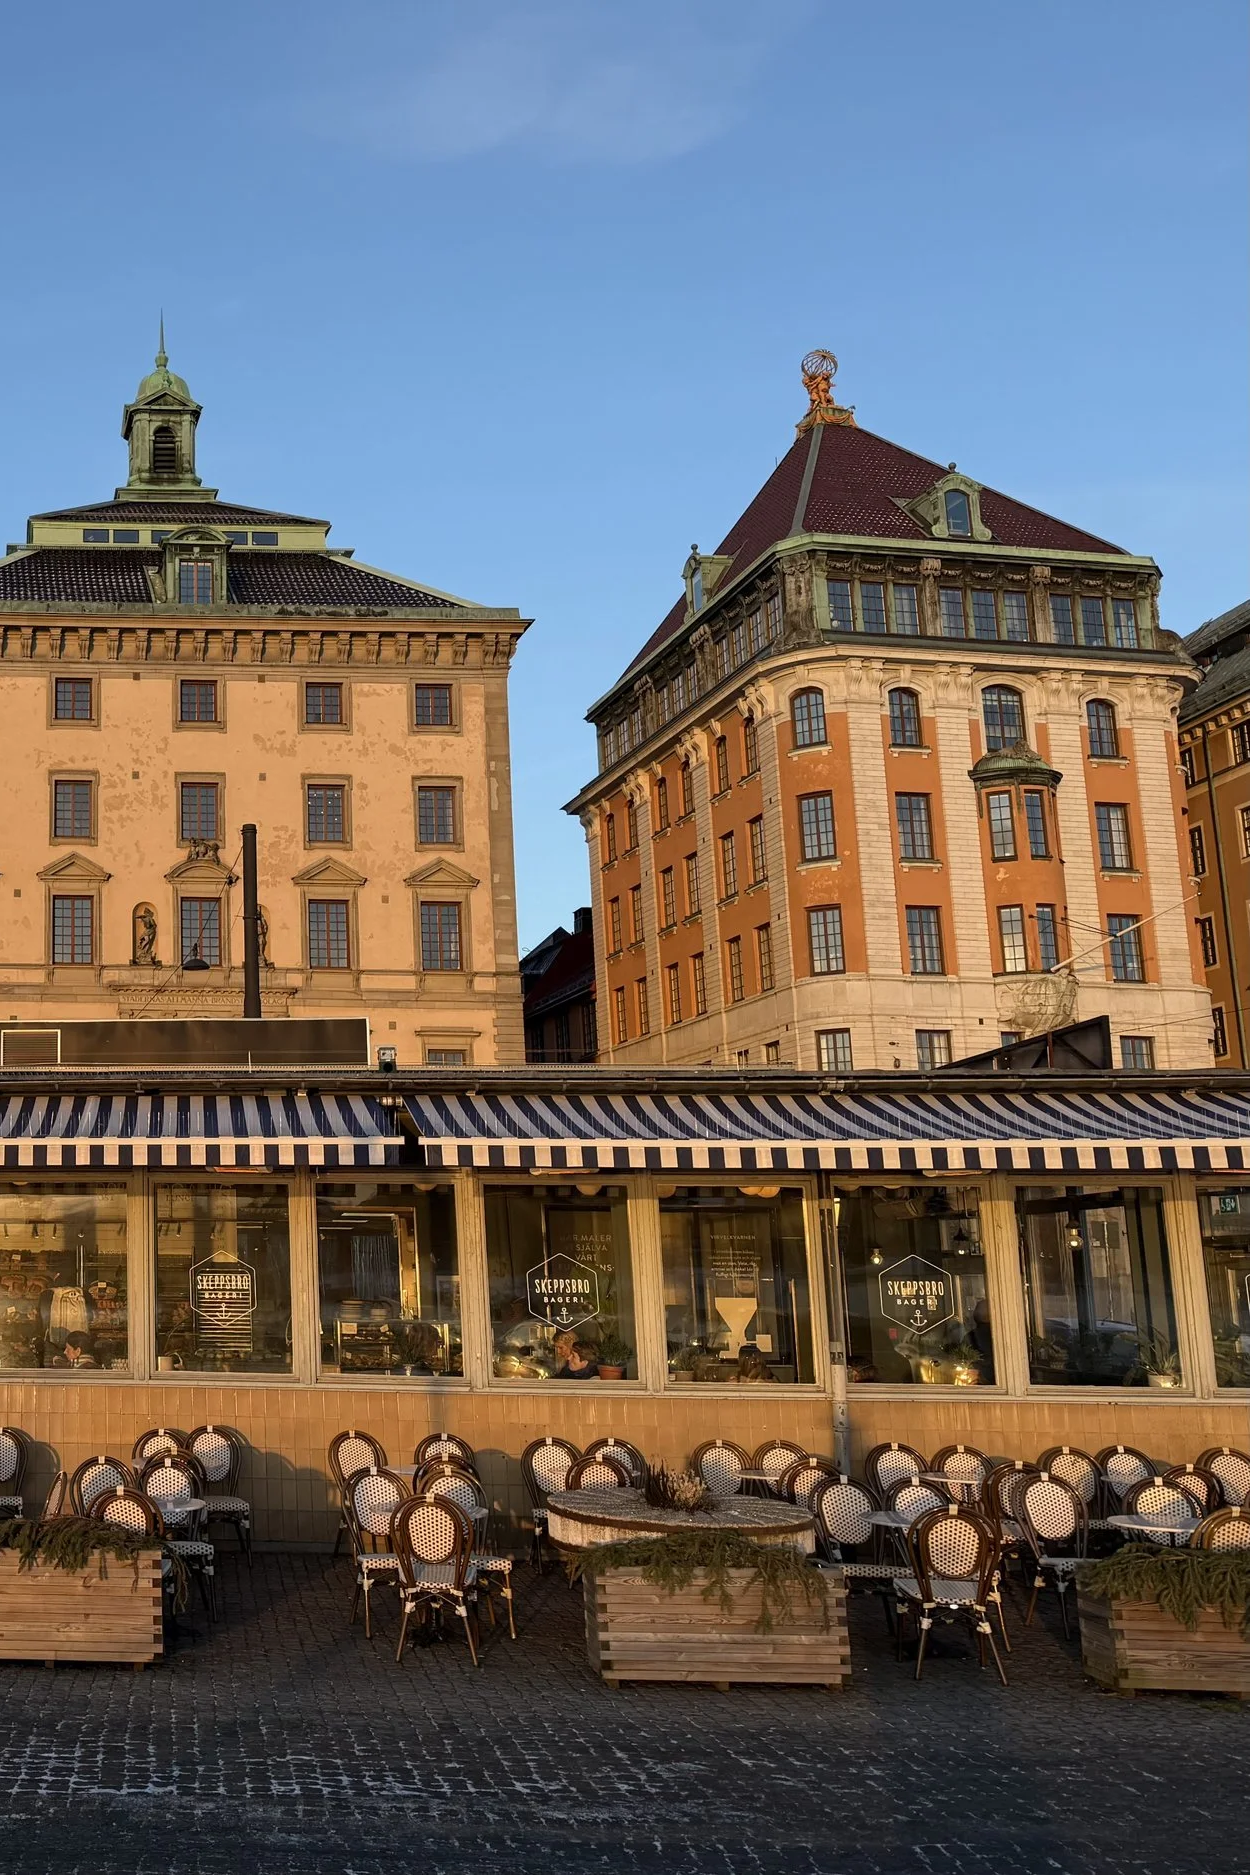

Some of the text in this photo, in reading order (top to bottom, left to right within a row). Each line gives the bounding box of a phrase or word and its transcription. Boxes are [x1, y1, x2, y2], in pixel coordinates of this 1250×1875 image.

[581, 1234, 612, 1242] MALER
[196, 1275, 249, 1290] SKEPPSBRO
[534, 1278, 590, 1294] SKEPPSBRO
[887, 1280, 944, 1296] SKEPPSBRO
[204, 1291, 242, 1299] BAGERI
[543, 1296, 584, 1304] BAGERI
[896, 1298, 938, 1306] BAGERI
